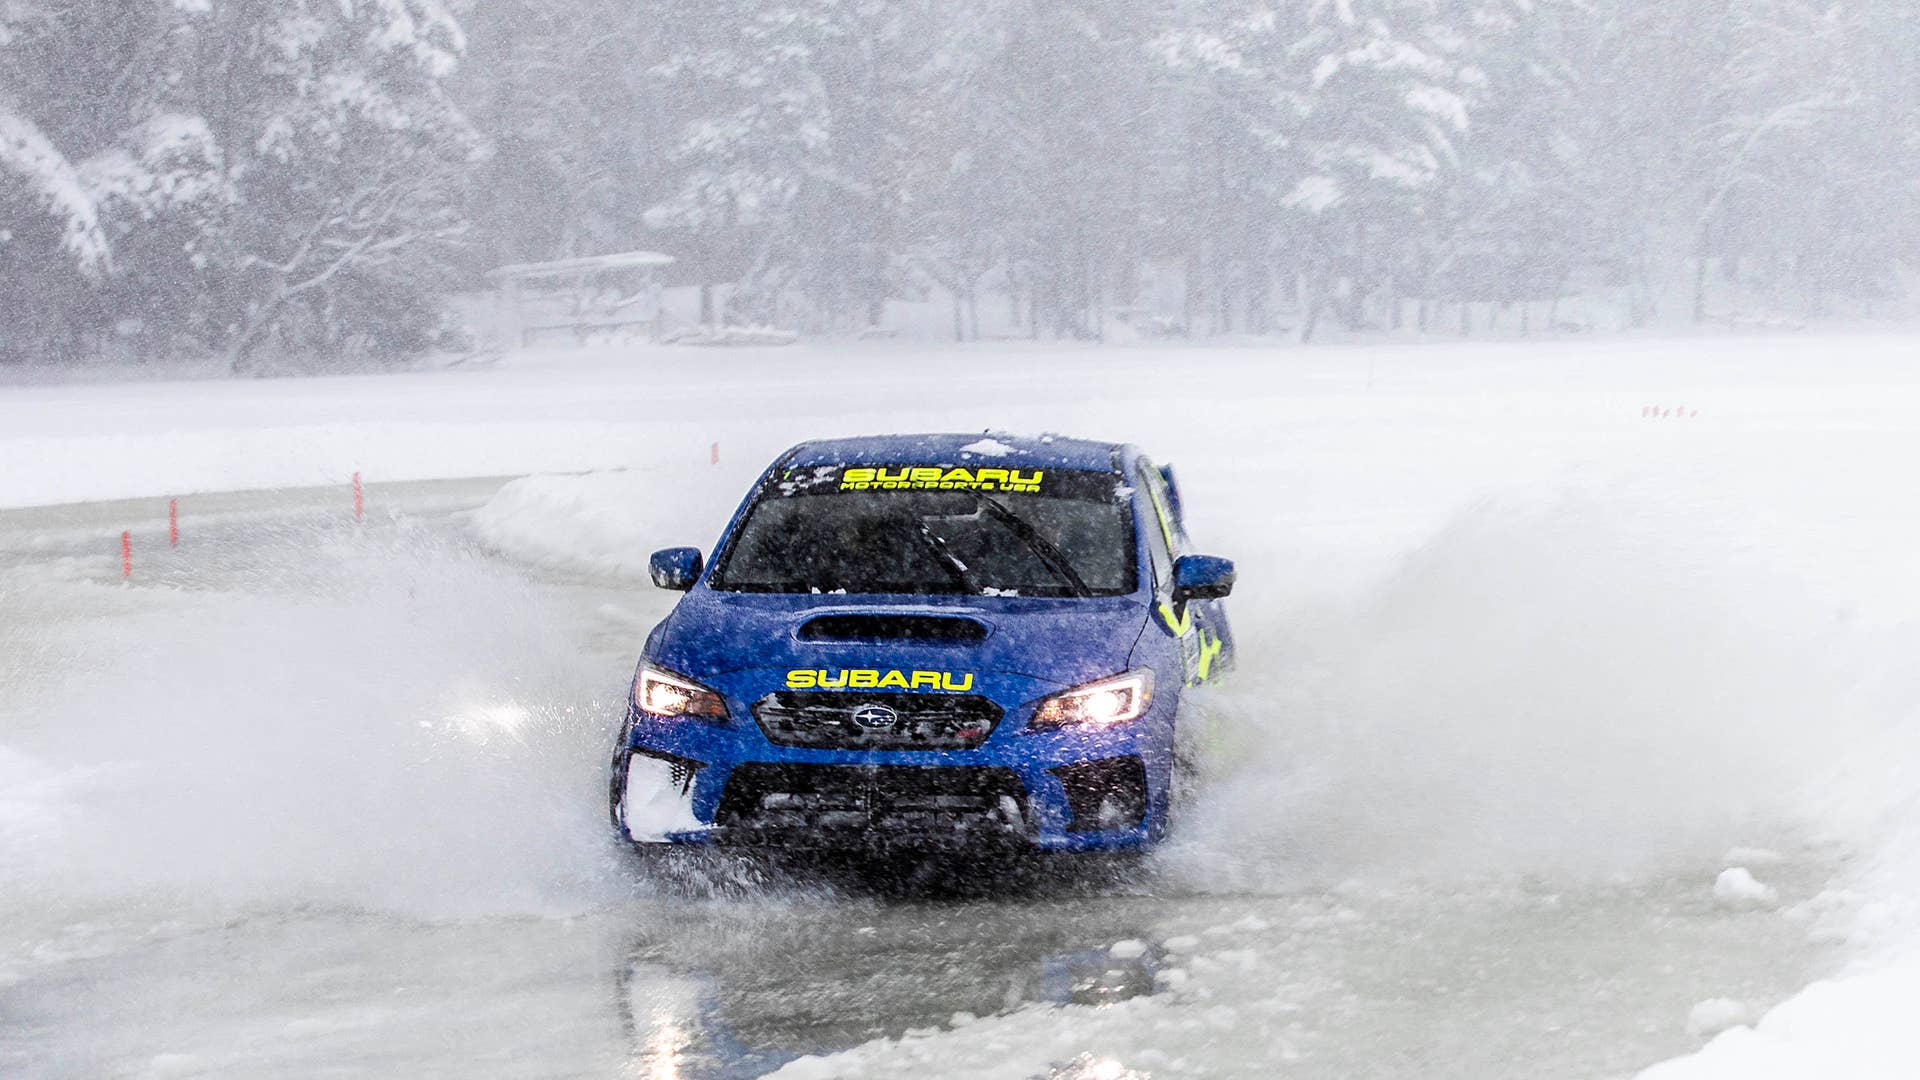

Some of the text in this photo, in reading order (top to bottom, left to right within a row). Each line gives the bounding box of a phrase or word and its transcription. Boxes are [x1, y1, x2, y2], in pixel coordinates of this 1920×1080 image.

[842, 468, 1043, 484] SUBARU
[840, 481, 1040, 492] MOTORSPORTS USA
[786, 670, 974, 691] SUBARU
